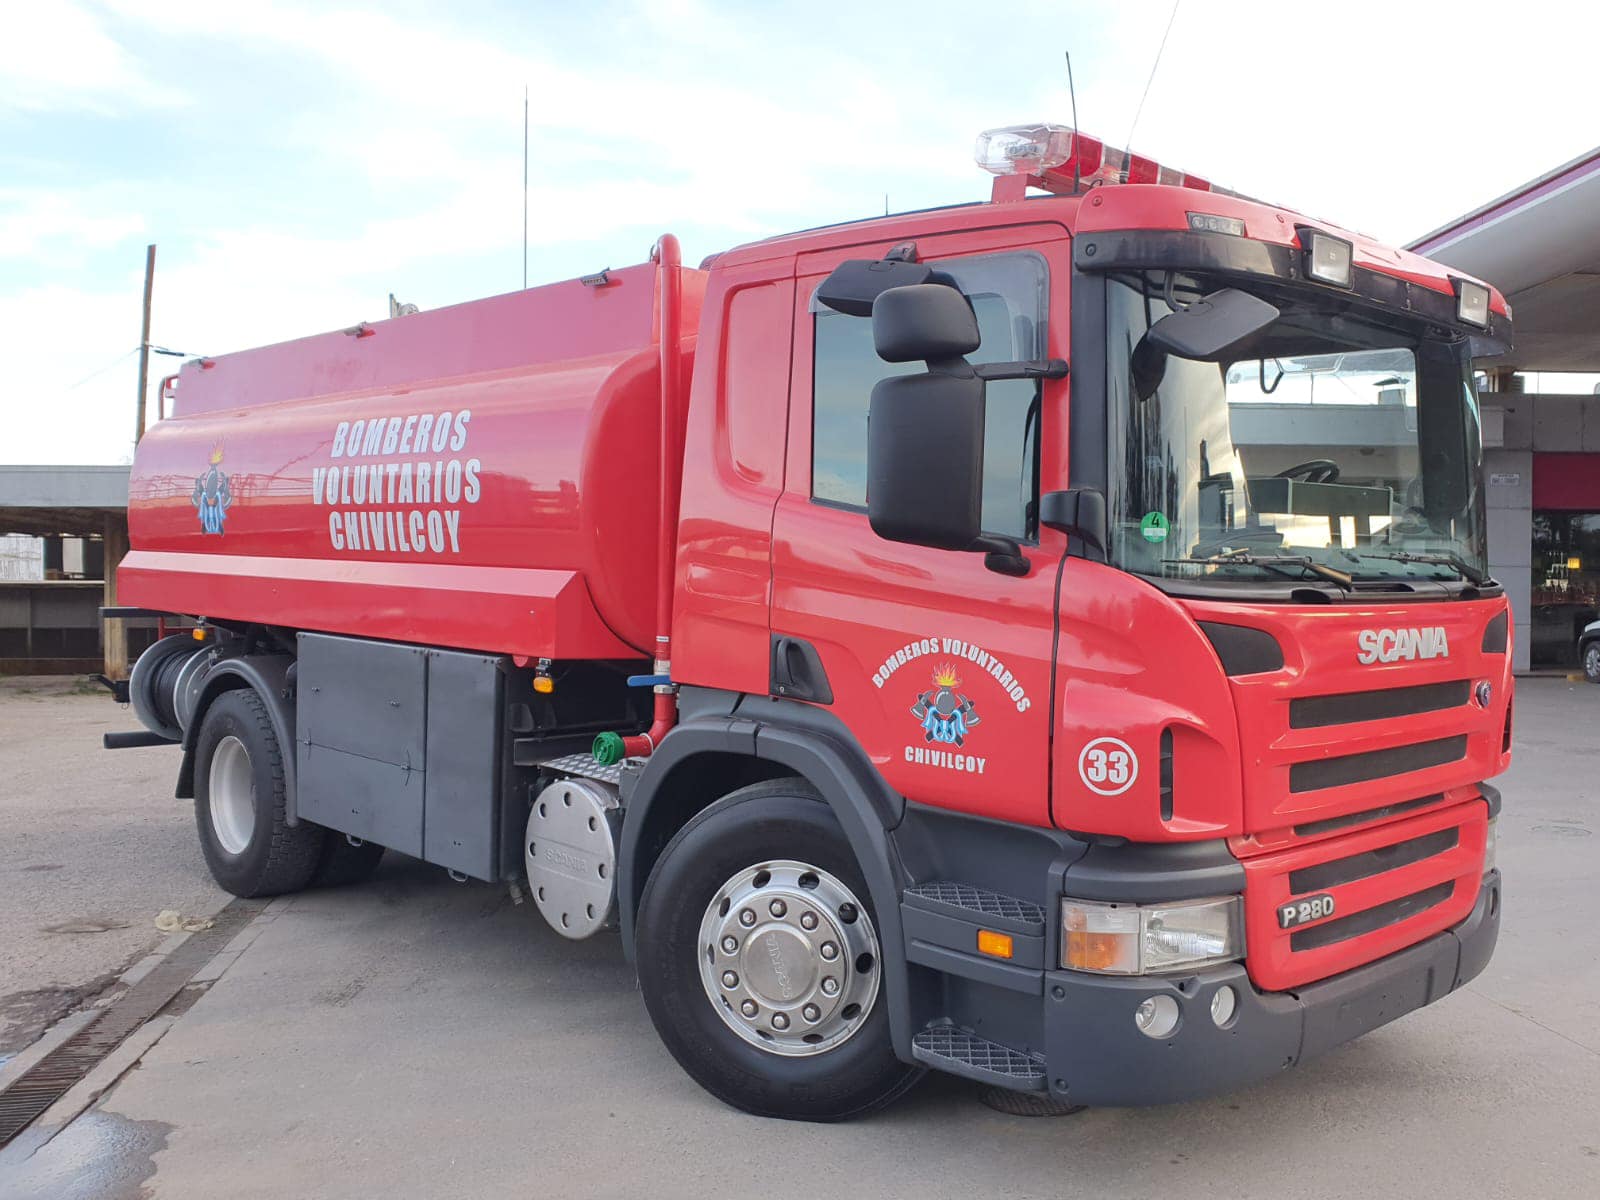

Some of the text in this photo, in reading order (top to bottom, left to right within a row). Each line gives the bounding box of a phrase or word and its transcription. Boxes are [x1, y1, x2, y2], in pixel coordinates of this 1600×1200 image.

[330, 409, 471, 458] BOMBEROS
[312, 458, 481, 505] VOLUNTARIOS
[328, 510, 460, 553] CHIVILCOY
[1151, 512, 1160, 528] 4
[1357, 626, 1449, 665] SCANIA
[872, 637, 1031, 712] BOMBEROS VOLUNTARIOS
[904, 746, 986, 774] CHIVILCOY
[1087, 749, 1129, 784] 33
[1283, 896, 1334, 928] P 280
